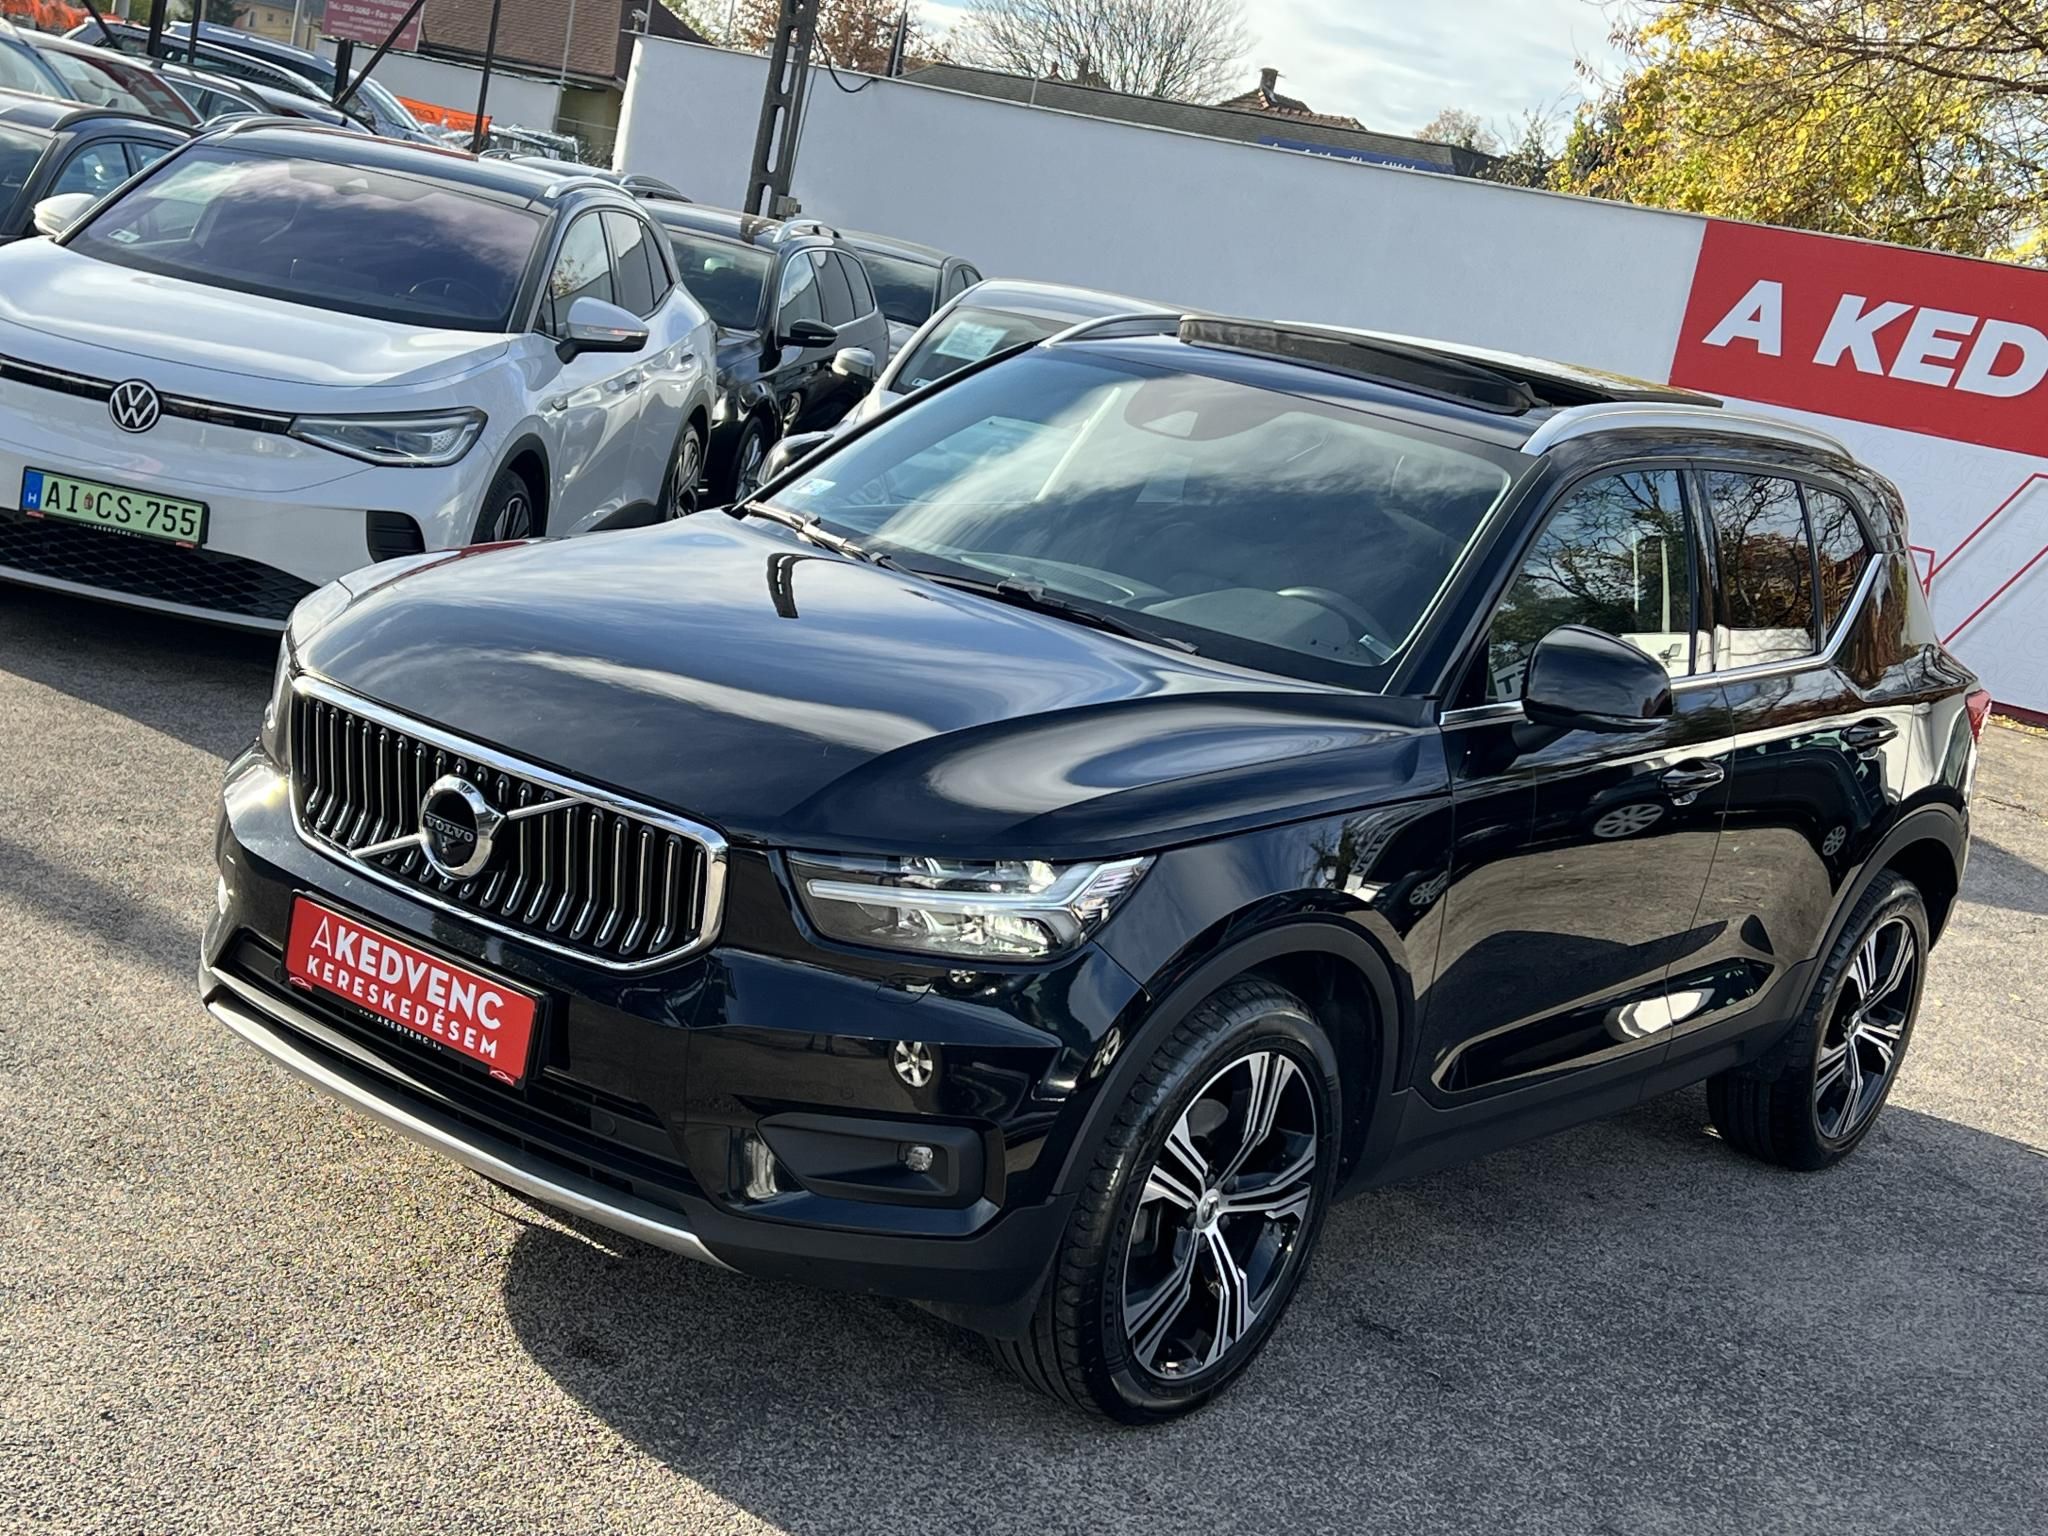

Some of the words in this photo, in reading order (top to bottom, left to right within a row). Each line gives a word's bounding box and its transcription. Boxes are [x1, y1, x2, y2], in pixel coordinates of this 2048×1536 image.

[1702, 279, 1783, 357] A
[1812, 293, 2048, 398] KED
[27, 492, 37, 504] H
[45, 481, 79, 513] AI
[96, 491, 196, 536] CS-755
[425, 815, 474, 842] VOLVO
[306, 955, 497, 1059] KERESKEDÉSEM
